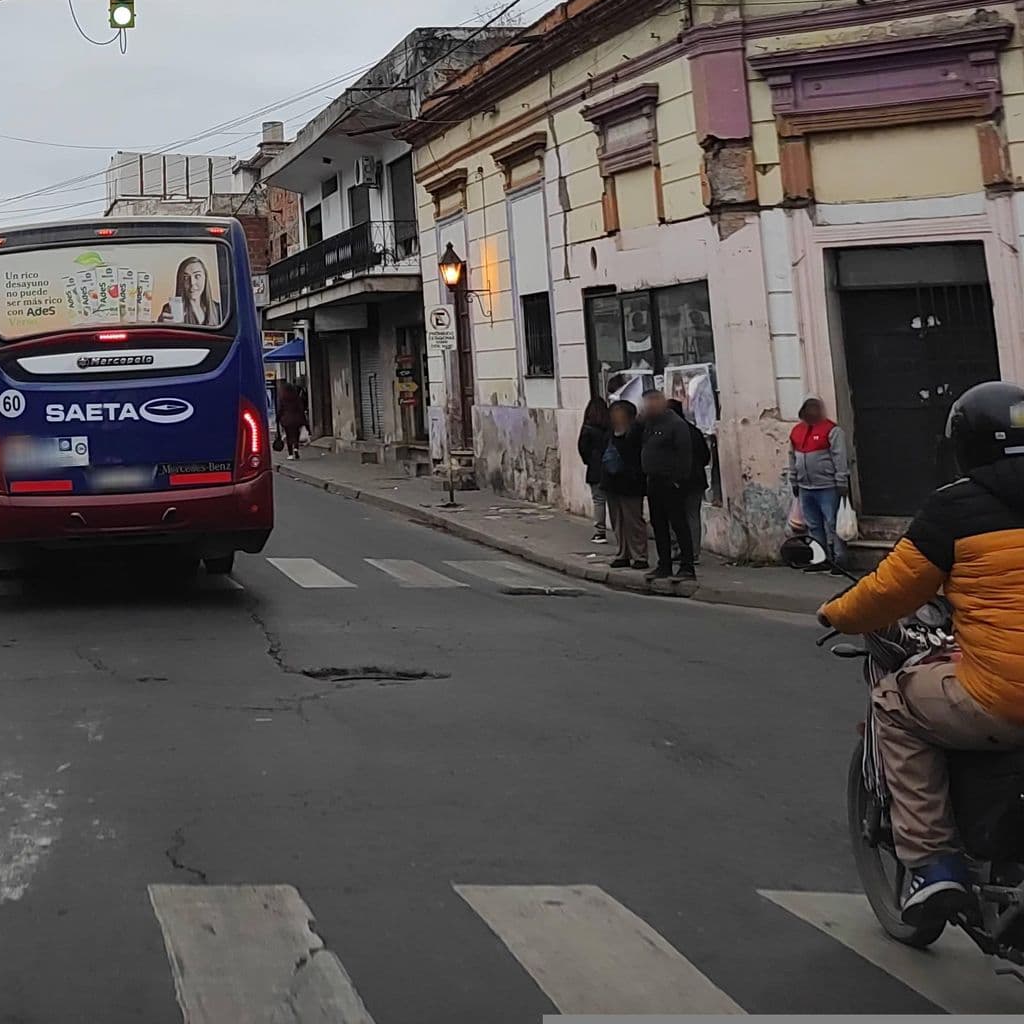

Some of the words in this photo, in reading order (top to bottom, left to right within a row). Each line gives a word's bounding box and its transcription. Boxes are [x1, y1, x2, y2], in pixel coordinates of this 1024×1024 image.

[5, 271, 19, 280] Un
[21, 271, 39, 280] rico
[5, 280, 49, 289] desayuno
[6, 290, 18, 298] no
[20, 287, 48, 298] puede
[6, 299, 22, 307] ser
[44, 295, 63, 305] rico
[7, 308, 24, 317] con
[26, 305, 56, 317] AdeS
[2, 394, 21, 413] 60
[45, 402, 141, 423] SAETA
